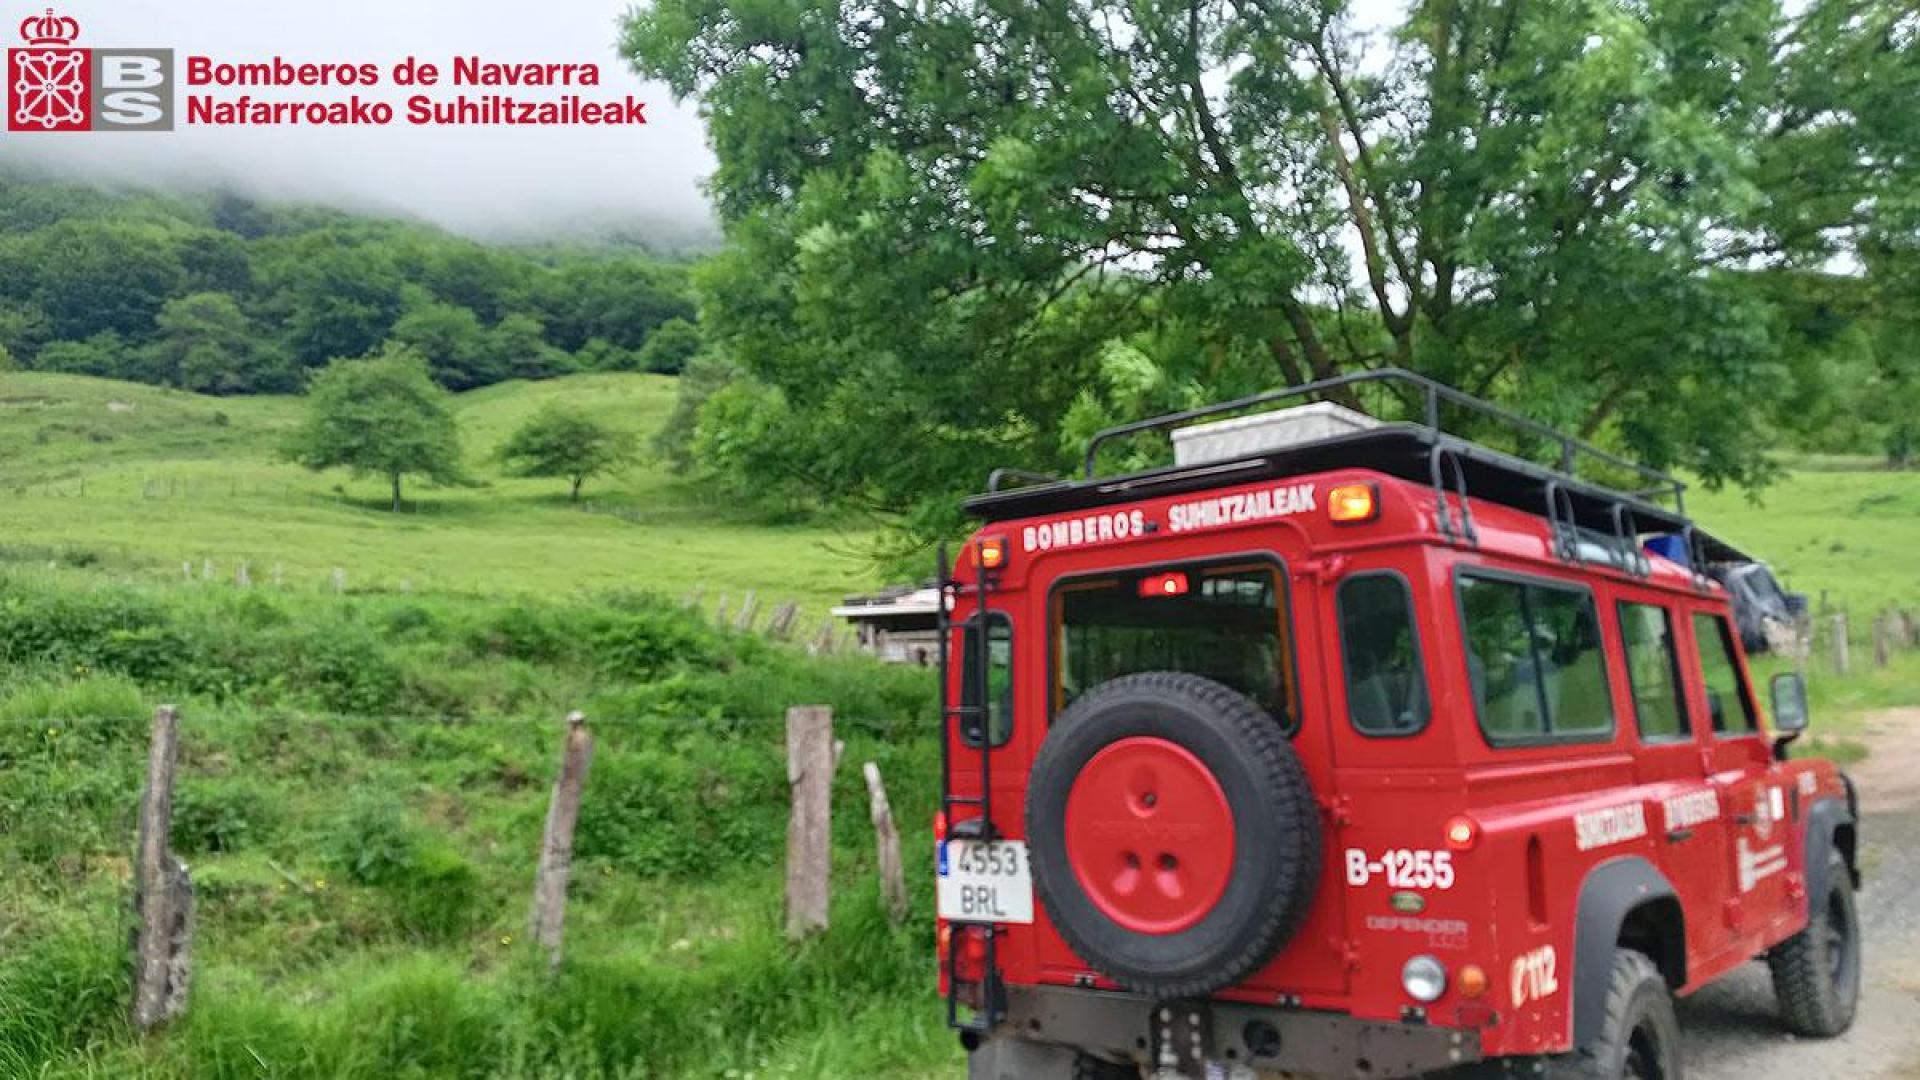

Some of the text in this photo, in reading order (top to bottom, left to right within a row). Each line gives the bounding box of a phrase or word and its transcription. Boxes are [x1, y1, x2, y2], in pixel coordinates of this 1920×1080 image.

[1023, 484, 1317, 552] BOMBEROS SUHILTZAILEAK
[959, 842, 1017, 876] 4553
[1345, 849, 1455, 889] B-1255
[961, 885, 1006, 916] BRL
